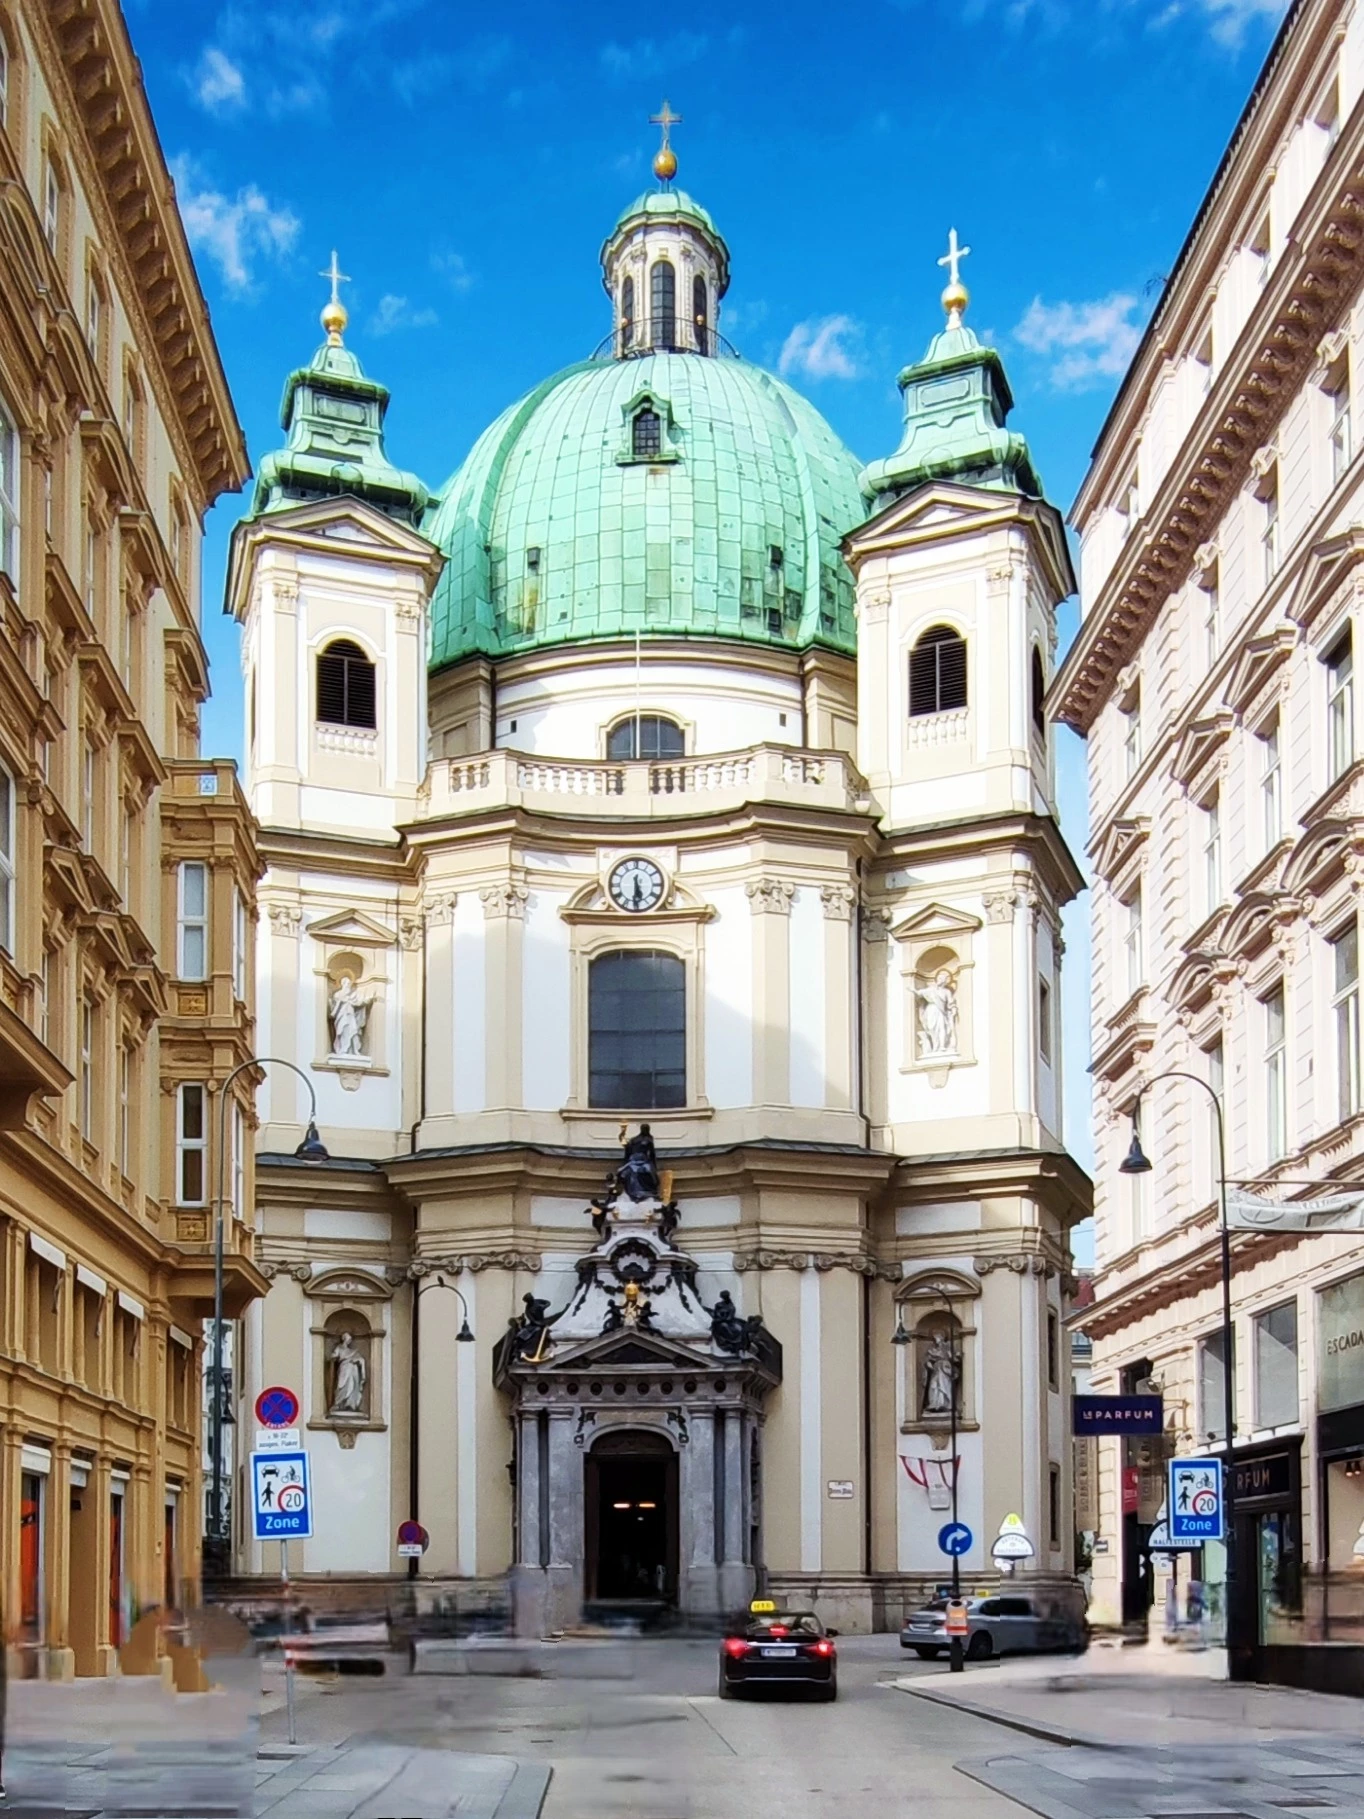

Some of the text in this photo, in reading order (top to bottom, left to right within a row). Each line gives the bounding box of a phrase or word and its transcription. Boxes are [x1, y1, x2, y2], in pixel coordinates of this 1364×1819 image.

[1327, 1330, 1364, 1355] ESCADA
[1095, 1410, 1153, 1419] PARFUM
[285, 1493, 301, 1508] 20
[1199, 1498, 1214, 1512] 20
[265, 1516, 300, 1530] Zone
[1181, 1518, 1212, 1531] Zone
